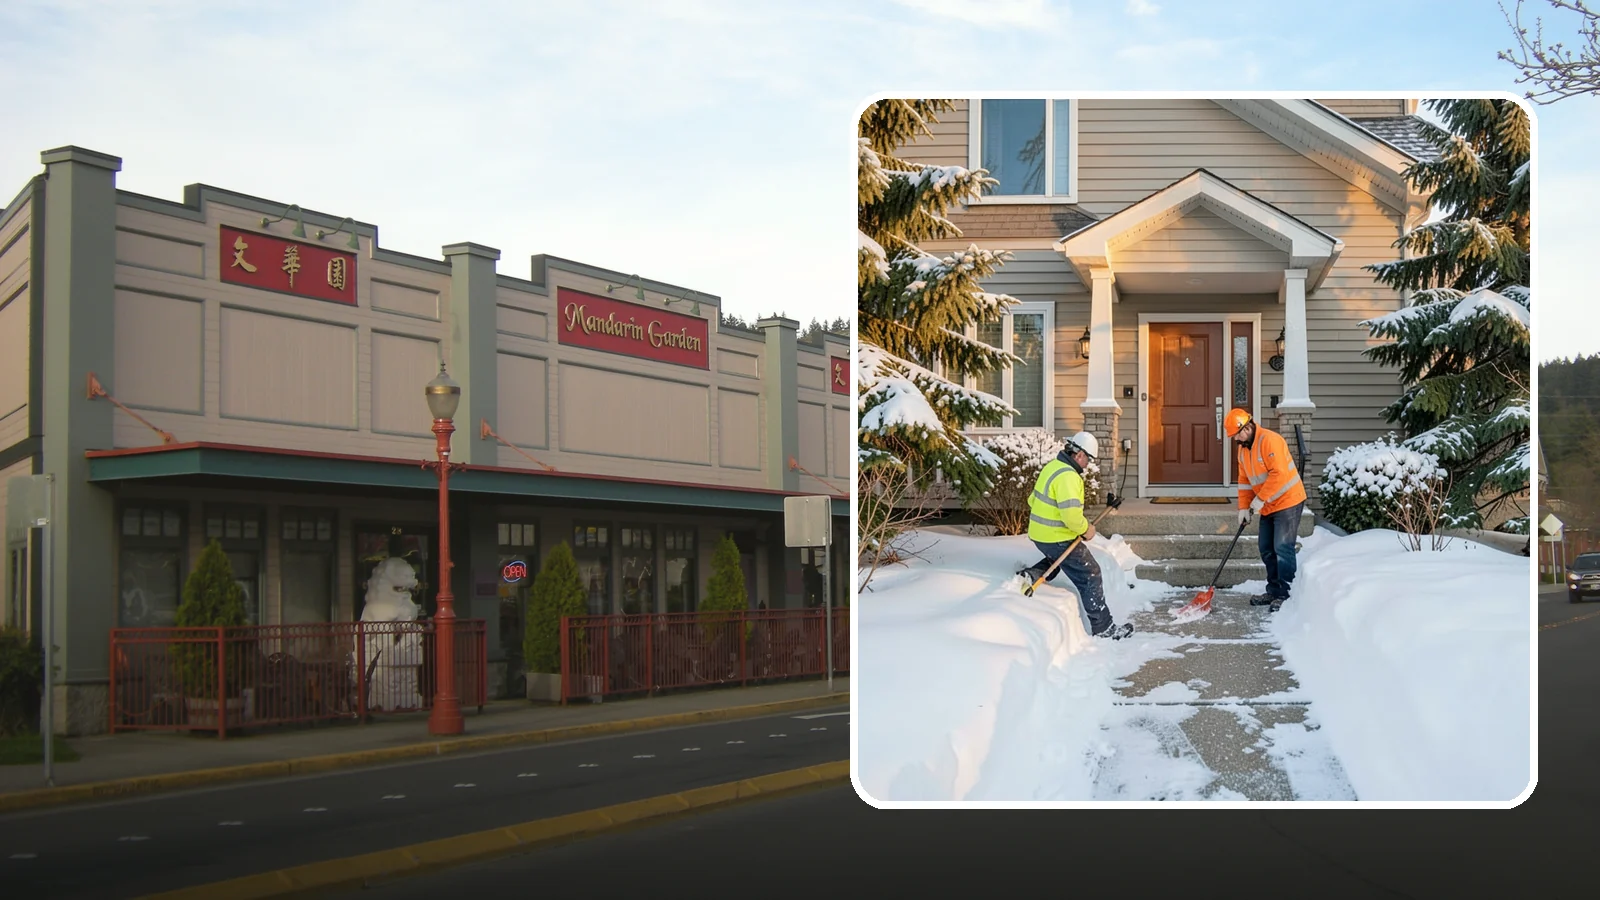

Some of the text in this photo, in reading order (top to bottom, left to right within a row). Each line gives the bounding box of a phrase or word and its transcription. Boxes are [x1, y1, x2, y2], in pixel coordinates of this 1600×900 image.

[230, 236, 346, 290] 文華園
[564, 302, 701, 352] Mandarin Garden
[503, 565, 527, 578] OPEN
